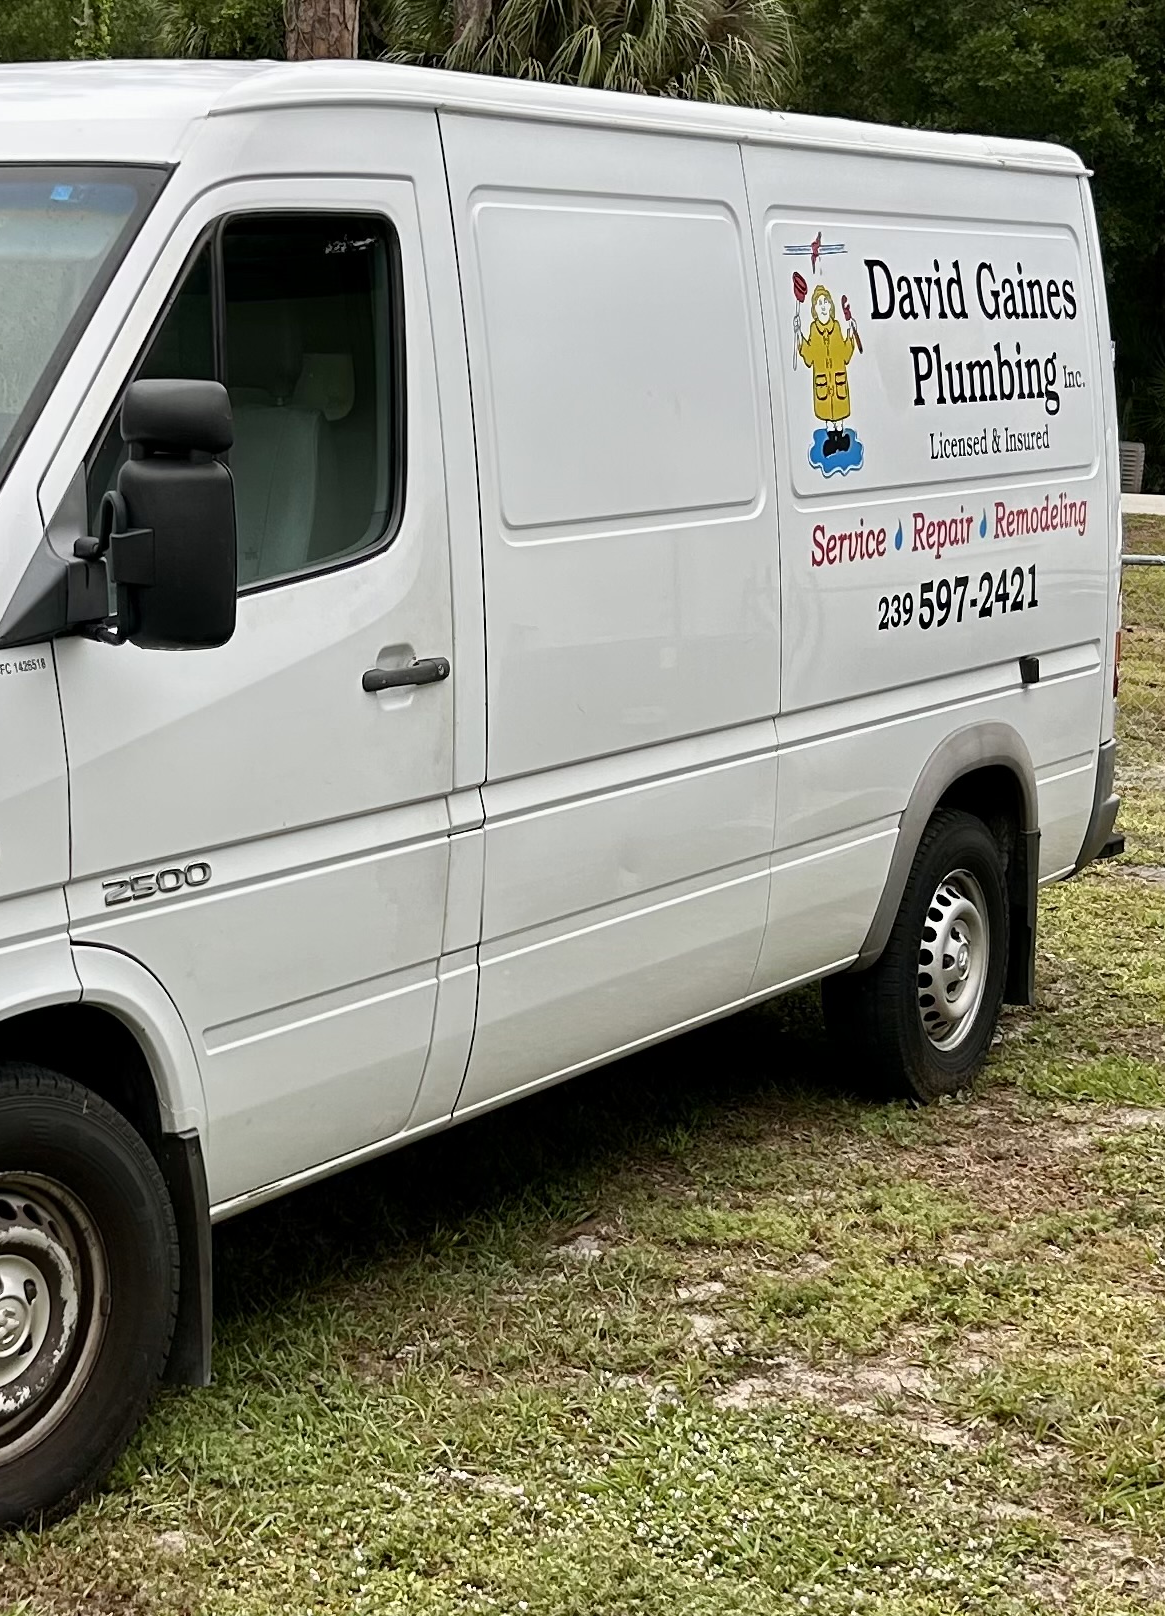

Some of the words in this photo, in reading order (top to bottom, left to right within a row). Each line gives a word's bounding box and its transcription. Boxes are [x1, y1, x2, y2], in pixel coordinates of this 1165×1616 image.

[864, 259, 968, 320] David
[976, 262, 1077, 320] Gaines
[910, 342, 1060, 415] Plumbing
[1063, 365, 1086, 388] Inc.
[930, 429, 988, 460] Licensed
[991, 430, 1001, 453] &
[1004, 424, 1050, 453] Insured
[811, 518, 886, 567] Service
[911, 505, 973, 559] Repair
[993, 492, 1087, 539] Remodeling
[878, 592, 914, 631] 239
[918, 563, 1039, 630] 597-2421
[102, 861, 212, 907] 2500
